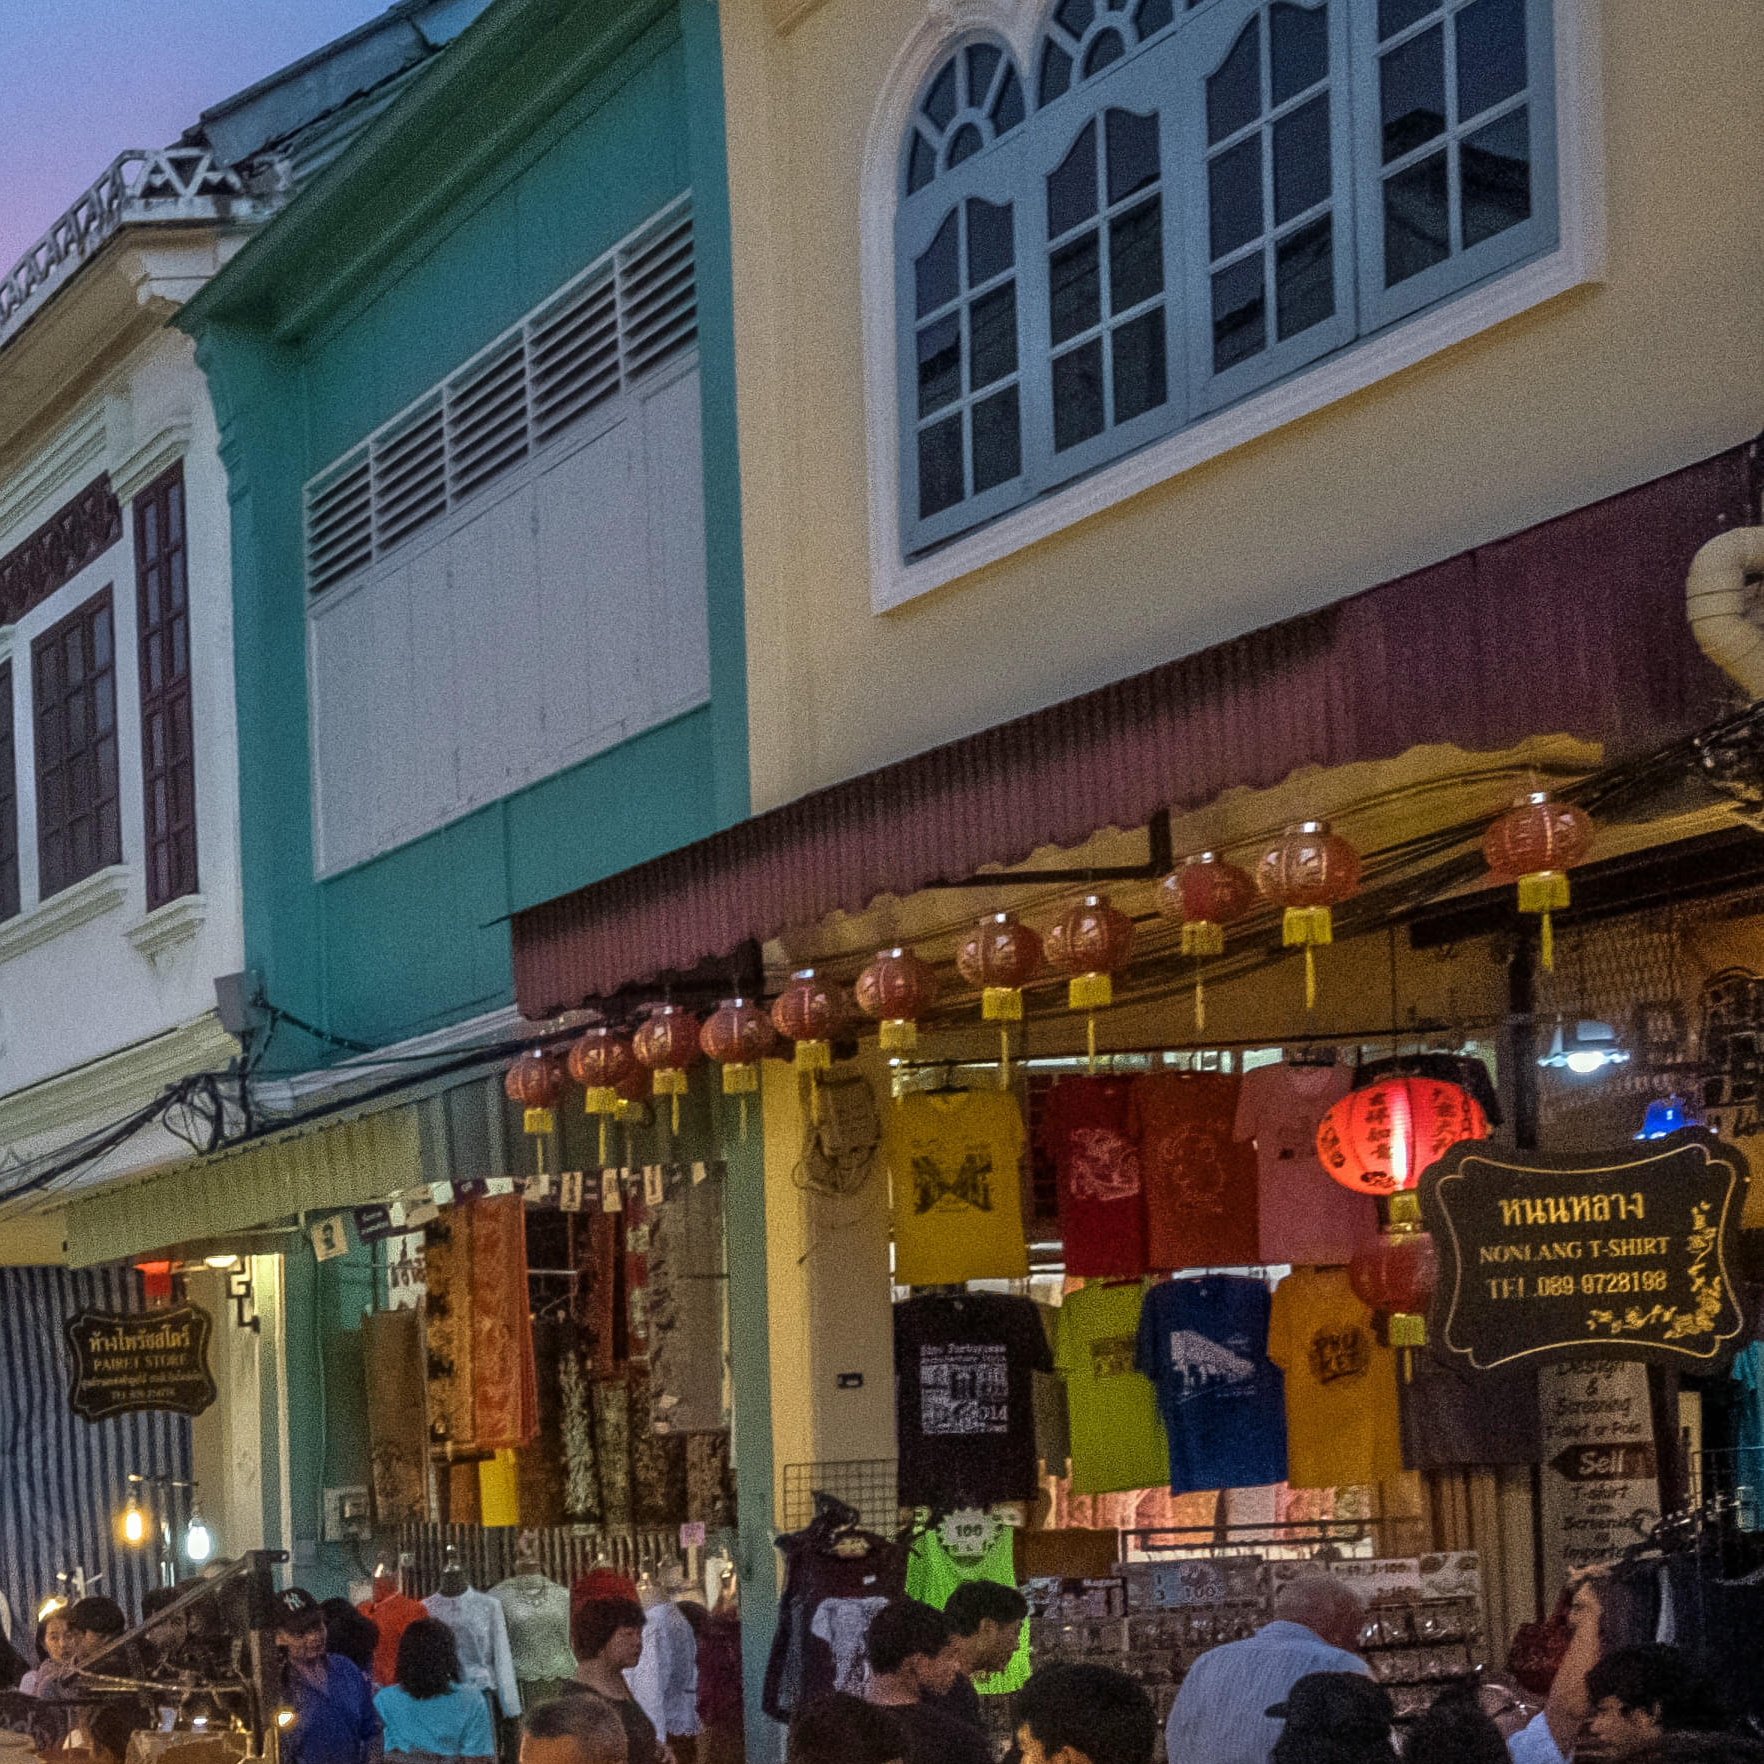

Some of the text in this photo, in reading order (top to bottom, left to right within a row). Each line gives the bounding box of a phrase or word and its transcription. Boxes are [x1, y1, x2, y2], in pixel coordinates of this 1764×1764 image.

[1479, 1236, 1671, 1264] NONLANG T-SHIRT
[1578, 1450, 1625, 1475] Sell
